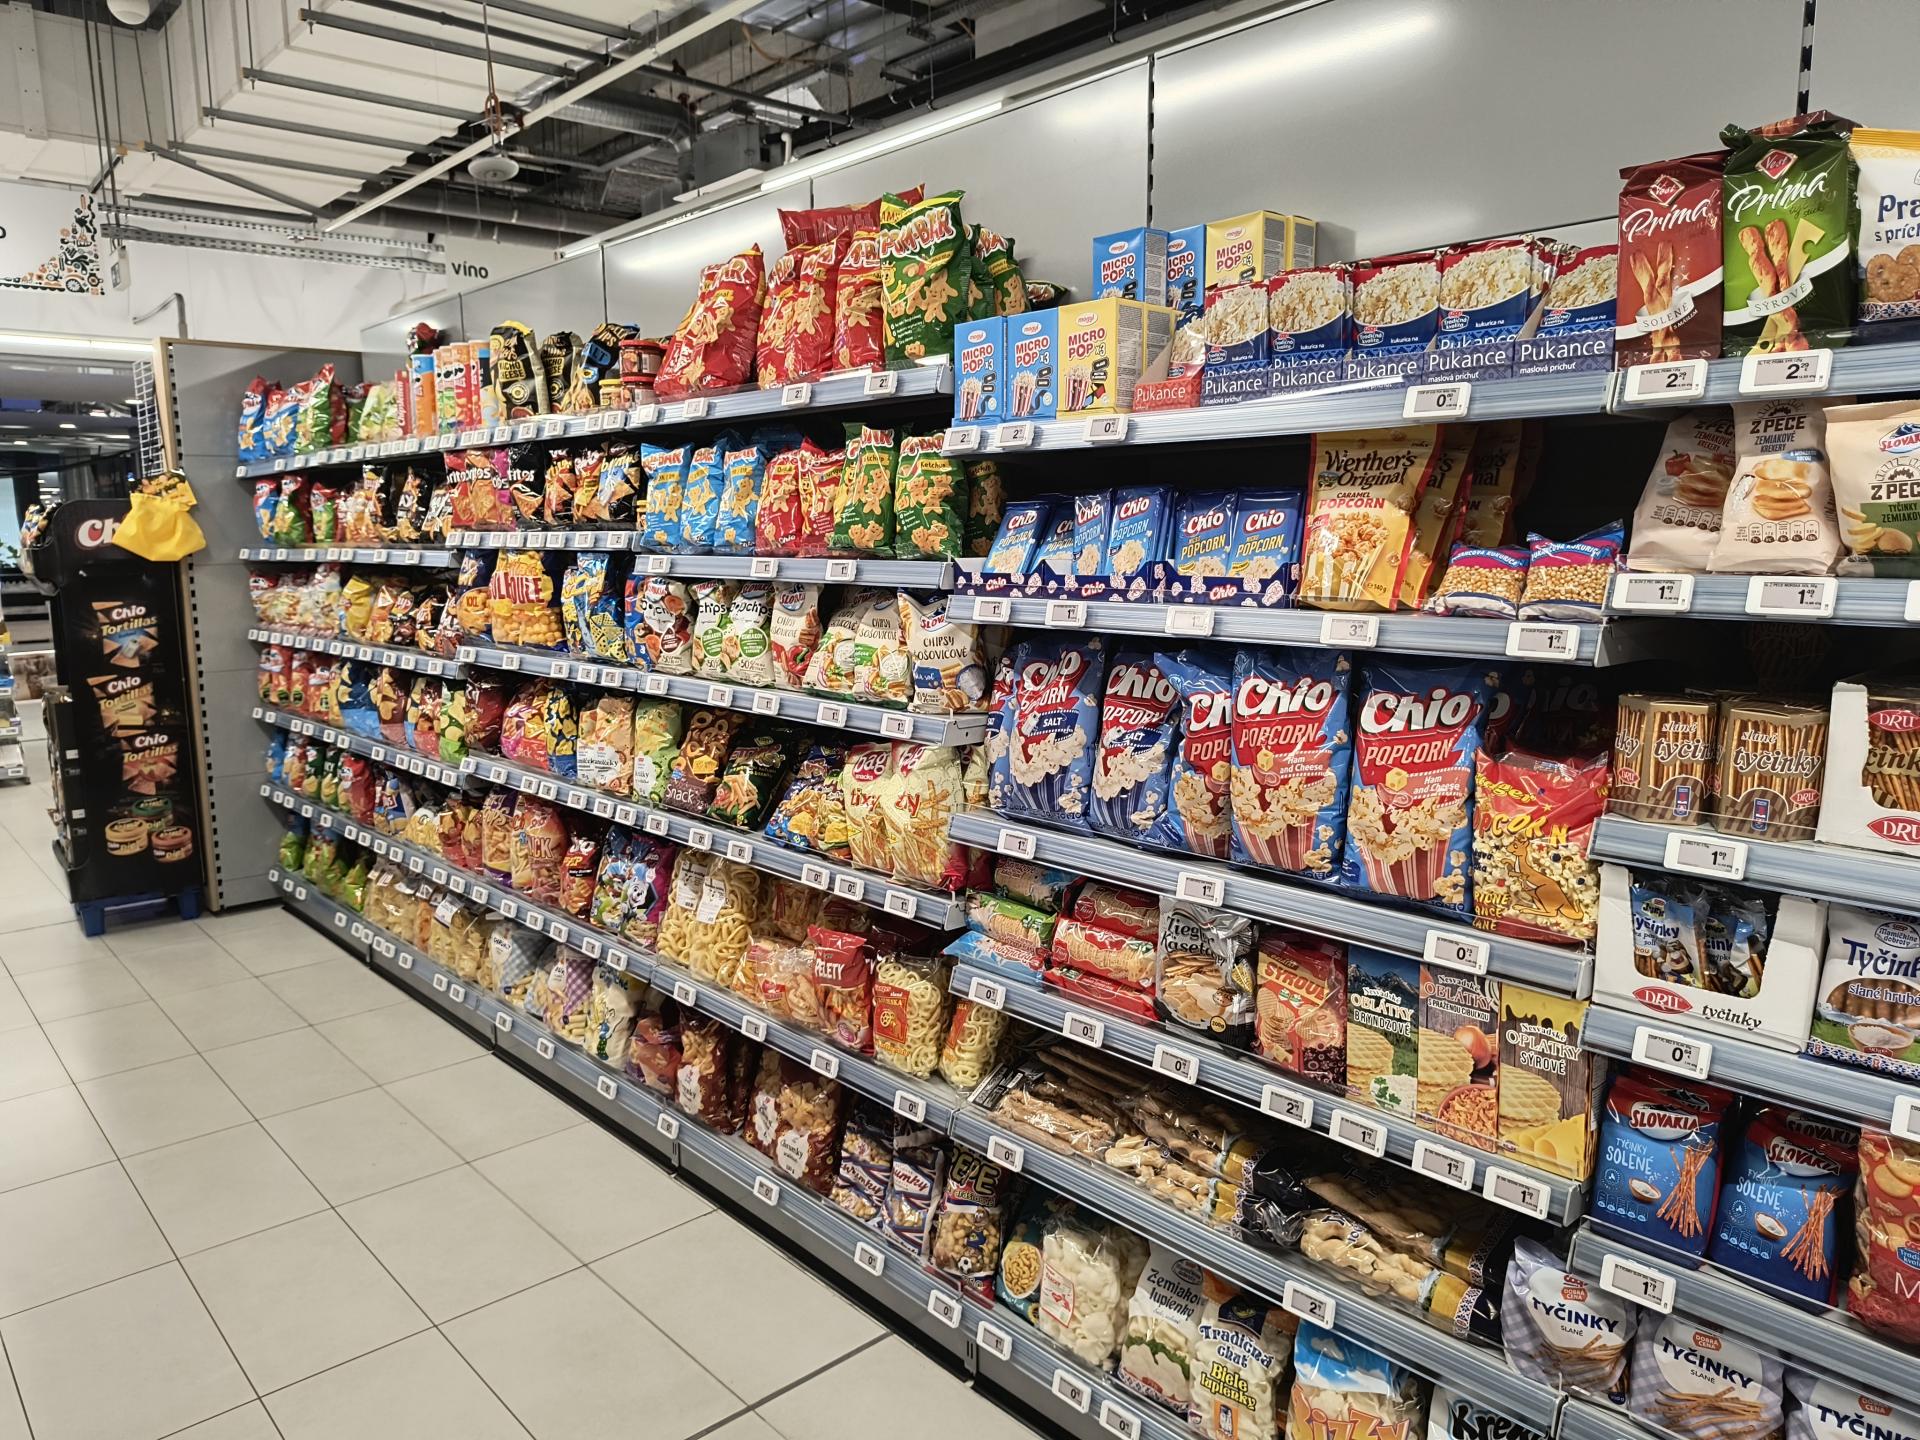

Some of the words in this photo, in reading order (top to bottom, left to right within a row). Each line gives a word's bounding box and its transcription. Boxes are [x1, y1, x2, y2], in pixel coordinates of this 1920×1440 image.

[1216, 240, 1252, 259] MICRO
[451, 260, 489, 280] víno
[1102, 254, 1135, 272] MICRO
[1216, 255, 1242, 272] POP
[1103, 268, 1125, 284] POP
[1068, 327, 1105, 345] MICRO
[962, 344, 993, 362] MICRO
[1015, 337, 1049, 354] MICRO
[1068, 343, 1094, 359] POP
[1521, 339, 1606, 362] Pukance
[963, 360, 984, 374] POP
[1016, 352, 1039, 366] POP
[1429, 350, 1506, 371] Pukance
[1347, 358, 1418, 380] Pukance
[1520, 365, 1548, 374] maslová
[1786, 363, 1800, 380] 2
[1204, 375, 1263, 396] Pukance
[1272, 369, 1336, 388] Pukance
[1428, 374, 1454, 383] maslová
[1665, 375, 1678, 388] 2
[1136, 385, 1186, 401] Pukance
[1436, 394, 1446, 407] 0
[1750, 420, 1764, 434] Z
[1763, 415, 1807, 433] PECE
[1754, 430, 1796, 446] ZEMIAKOVÉ
[1325, 449, 1417, 473] Werther's
[1337, 468, 1407, 490] Original
[1336, 491, 1371, 499] CARAMEL
[1871, 485, 1883, 500] Z
[1120, 497, 1150, 519] Chio
[1318, 497, 1385, 510] POPCORN
[1007, 510, 1037, 531] Chio
[1187, 511, 1224, 535] Chio
[1245, 508, 1286, 532] Chio
[1112, 518, 1149, 542] POPCORN
[1181, 534, 1226, 560] POPCORN
[1237, 534, 1285, 557] POPCORN
[986, 577, 1007, 590] Chio
[1082, 582, 1105, 596] Chio
[1210, 584, 1238, 599] Chio
[1659, 585, 1665, 600] 1
[1798, 589, 1806, 604] 1
[111, 604, 146, 621] Chio
[1106, 664, 1175, 702] Chio
[1237, 677, 1333, 716] Chio
[1360, 688, 1472, 734] Chio
[1043, 716, 1063, 728] SALT
[1661, 720, 1698, 734] slané
[1880, 712, 1915, 729] DRU
[134, 732, 169, 749] Chio
[1125, 730, 1145, 741] SALT
[1239, 722, 1319, 749] POPCORN
[1363, 740, 1452, 767] POPCORN
[1733, 747, 1823, 778] tyčinky
[1279, 763, 1293, 773] and
[1294, 763, 1323, 773] Cheese
[1413, 784, 1429, 794] and
[1430, 782, 1460, 794] Cheese
[1424, 774, 1442, 784] Ham
[665, 783, 694, 804] Snack
[1711, 850, 1718, 866] 1
[1456, 947, 1466, 960] 0
[1423, 981, 1493, 1010] OBLÁTKY
[1848, 983, 1881, 1000] slané
[1350, 993, 1415, 1021] OBLÁTKY
[1353, 1010, 1411, 1037] BRYNDZOVÉ
[1702, 1003, 1762, 1031] tyčinky
[1520, 1050, 1567, 1075] SÝROVÉ
[1671, 1047, 1683, 1062] 0
[1629, 1108, 1700, 1132] SLOVAKIA
[1615, 1136, 1648, 1155] TYČINKY
[1606, 1145, 1653, 1175] SOLENÉ
[1736, 1176, 1784, 1211] SOLENÉ
[1643, 1281, 1650, 1294] 1
[1149, 1287, 1195, 1322] lupienky
[1532, 1296, 1619, 1334] TYČINKY
[1561, 1323, 1584, 1337] SLANÉ
[1200, 1324, 1275, 1370] Tradičná
[1217, 1344, 1250, 1369] chuť
[1661, 1336, 1754, 1389] TYČINKY
[1211, 1361, 1249, 1393] Biele
[1690, 1368, 1716, 1385] SLANÉ
[1200, 1372, 1257, 1412] lupienky
